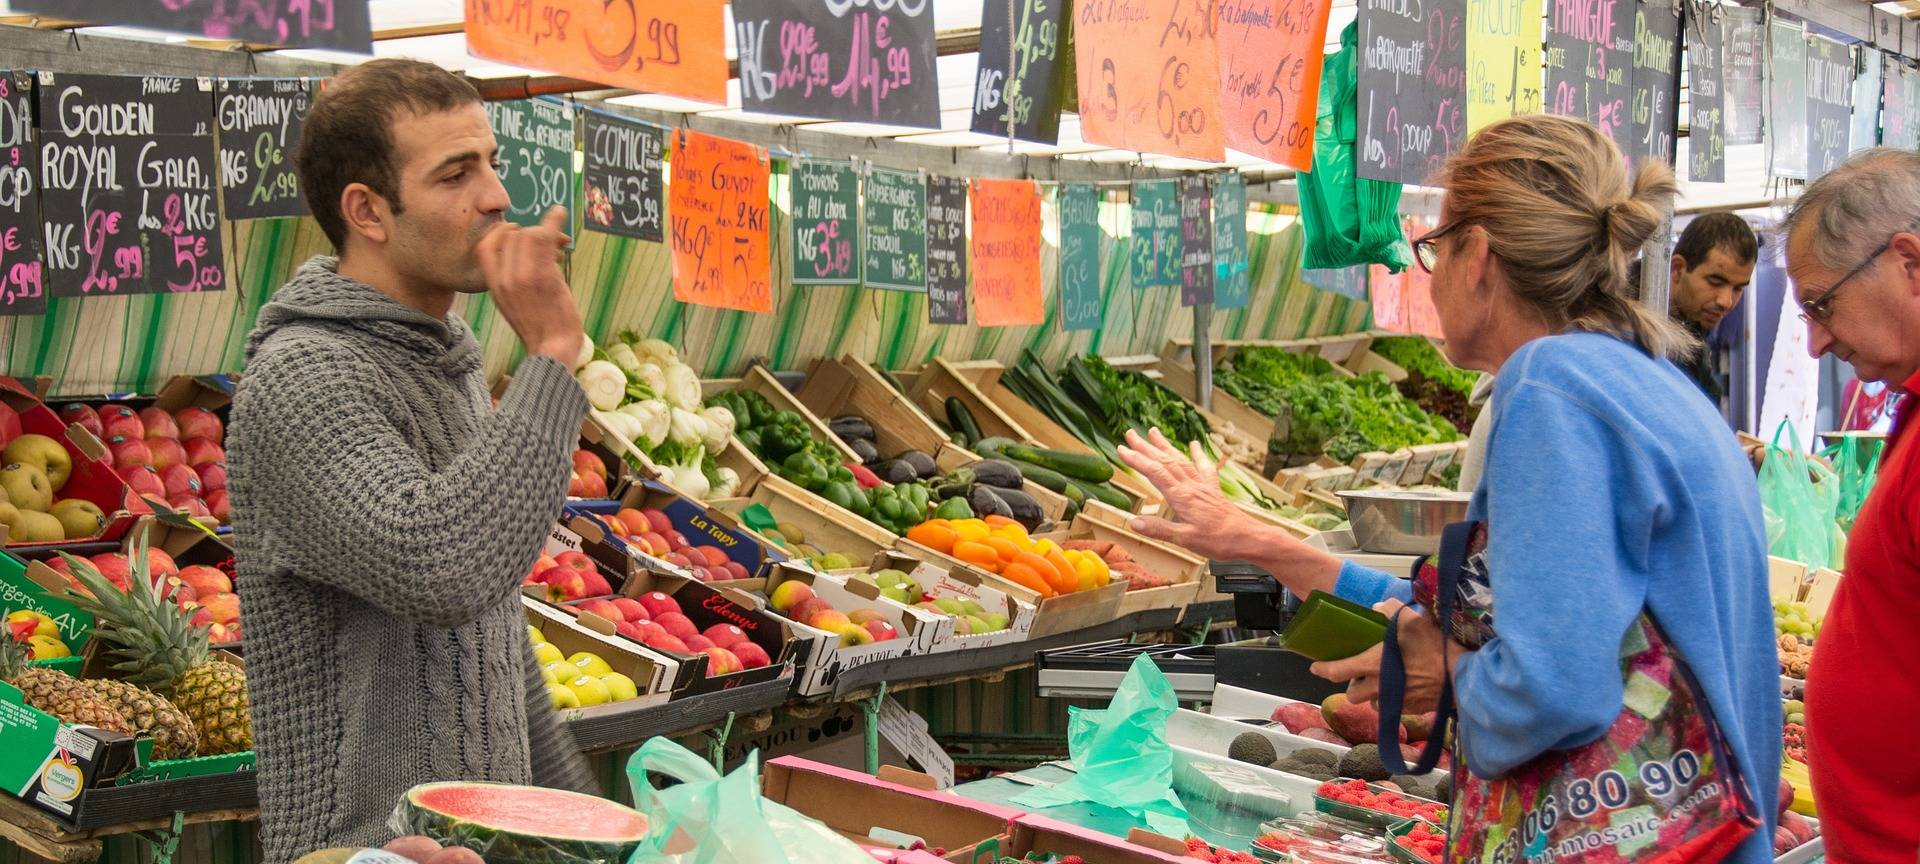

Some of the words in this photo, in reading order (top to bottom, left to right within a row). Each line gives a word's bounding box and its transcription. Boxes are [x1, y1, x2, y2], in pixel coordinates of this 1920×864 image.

[1553, 0, 1617, 50] MANGUE
[1632, 10, 1673, 74] BANANE
[739, 20, 778, 101] KG
[1596, 48, 1605, 80] 3
[142, 78, 182, 95] FRANCE
[976, 67, 1002, 115] KG
[1101, 58, 1118, 122] 3
[220, 94, 292, 148] GRANNY
[1386, 106, 1400, 168] 3
[220, 148, 248, 188] KG
[594, 123, 650, 174] COMICE
[42, 142, 122, 208] ROYAL
[608, 175, 625, 205] KG
[867, 179, 917, 208] AUBERGINES
[162, 193, 185, 236] 2
[184, 191, 216, 230] KG
[736, 201, 746, 228] 2
[893, 208, 910, 231] KG
[45, 222, 80, 270] KG
[797, 228, 817, 261] KG
[866, 226, 903, 254] FENOUIL
[892, 257, 906, 279] KG
[689, 515, 708, 530] La
[708, 524, 738, 547] Tapy
[1522, 794, 1559, 848] 06
[1566, 777, 1630, 819] 80
[1639, 748, 1700, 798] 90
